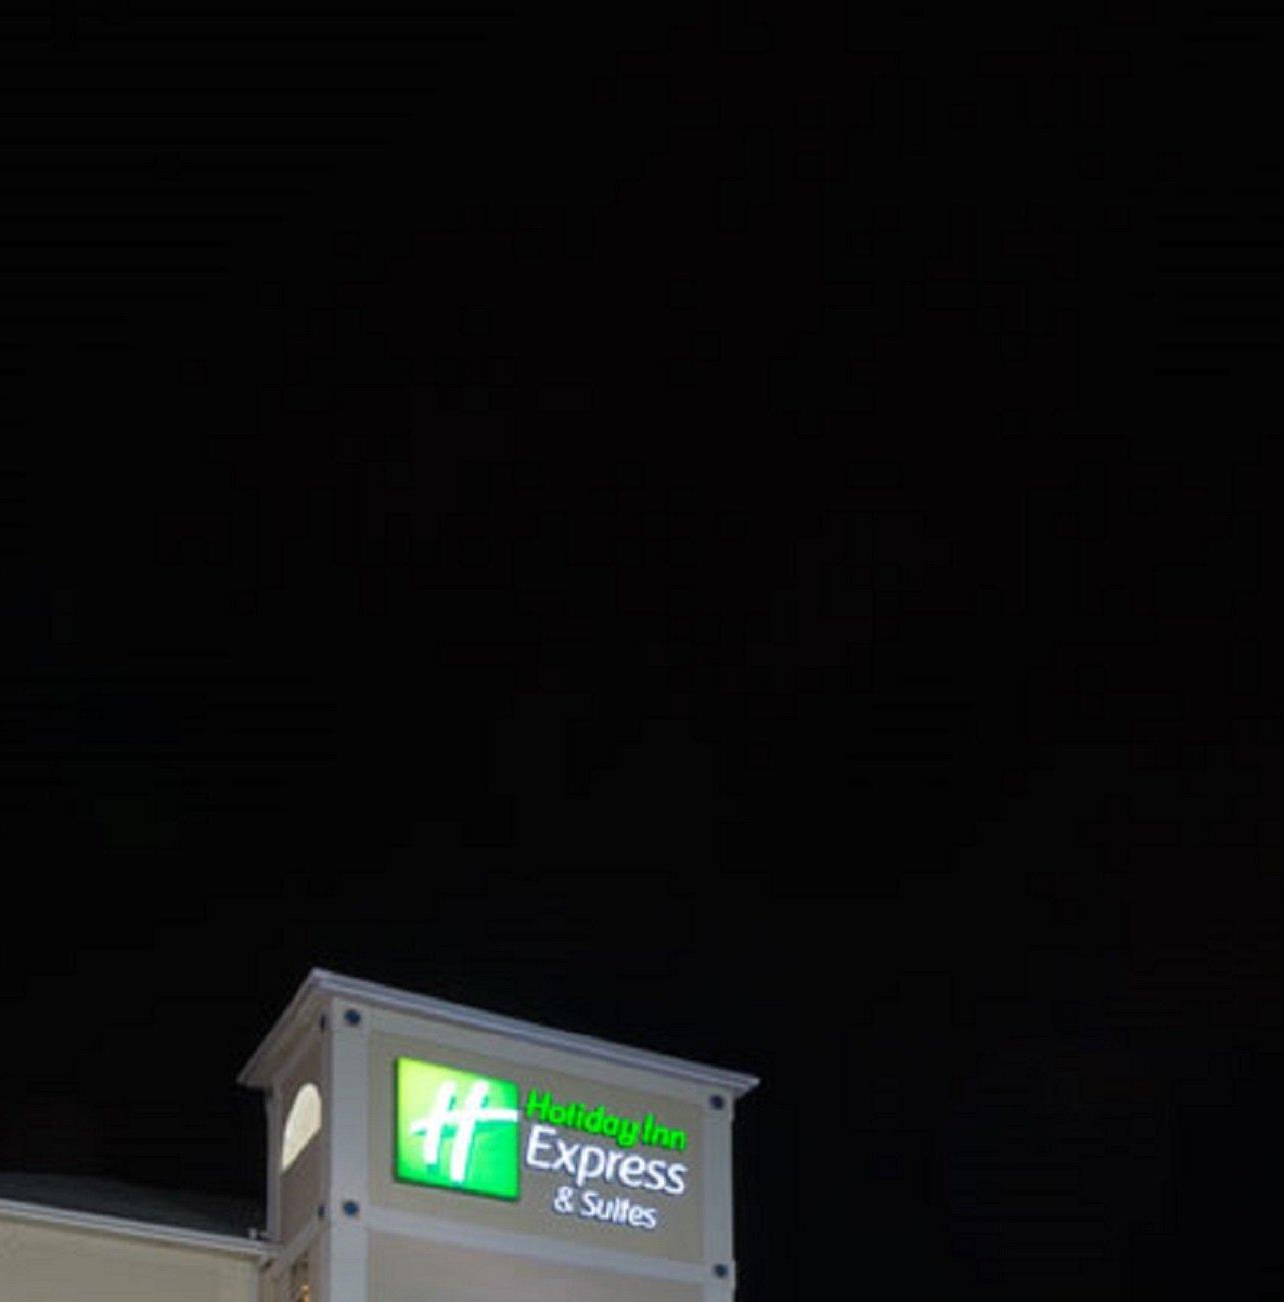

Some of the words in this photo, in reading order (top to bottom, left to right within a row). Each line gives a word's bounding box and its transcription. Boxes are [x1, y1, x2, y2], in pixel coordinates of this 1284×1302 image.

[524, 1088, 641, 1148] Holiday
[642, 1112, 688, 1151] Inn
[526, 1124, 689, 1195] Express
[553, 1185, 575, 1214] &
[580, 1189, 657, 1230] Suites
